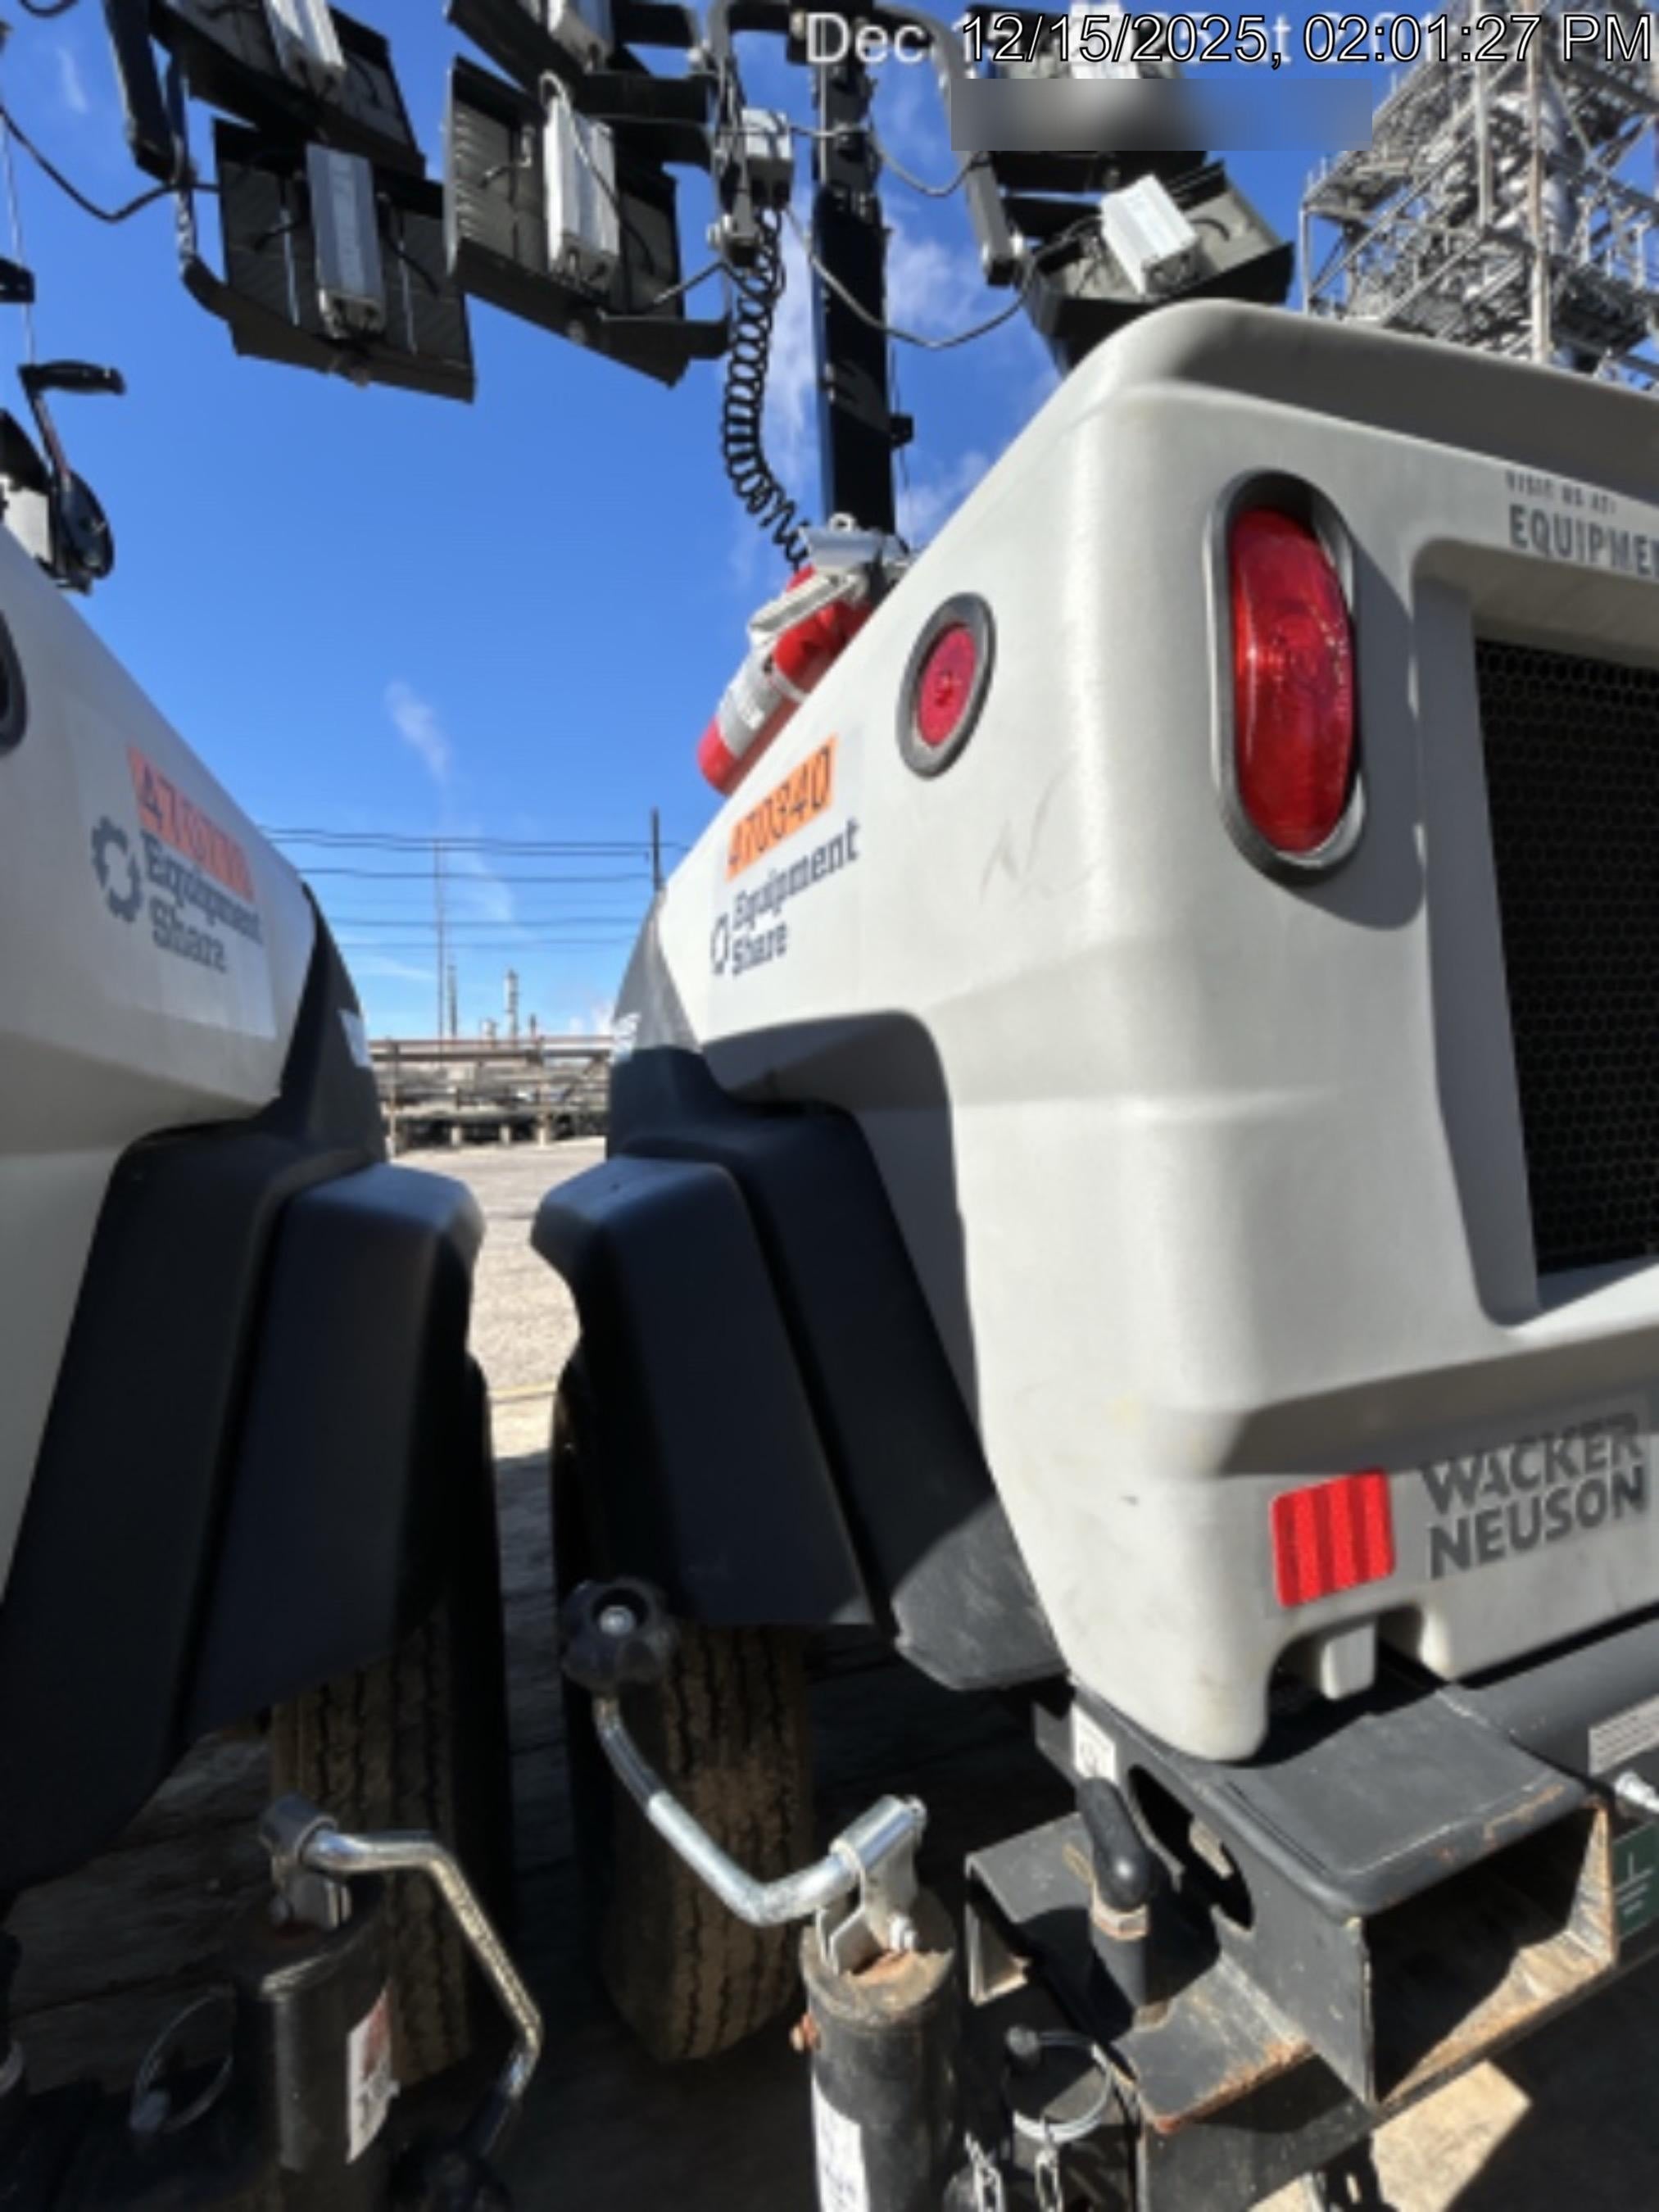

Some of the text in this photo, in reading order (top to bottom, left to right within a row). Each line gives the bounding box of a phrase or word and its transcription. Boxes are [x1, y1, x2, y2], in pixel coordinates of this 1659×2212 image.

[141, 827, 265, 945] Equipment
[733, 816, 859, 931] Equipment
[148, 896, 229, 975] Share
[732, 920, 787, 976] Share
[1420, 1412, 1643, 1515] WACKER
[1430, 1463, 1647, 1580] NEUSON
